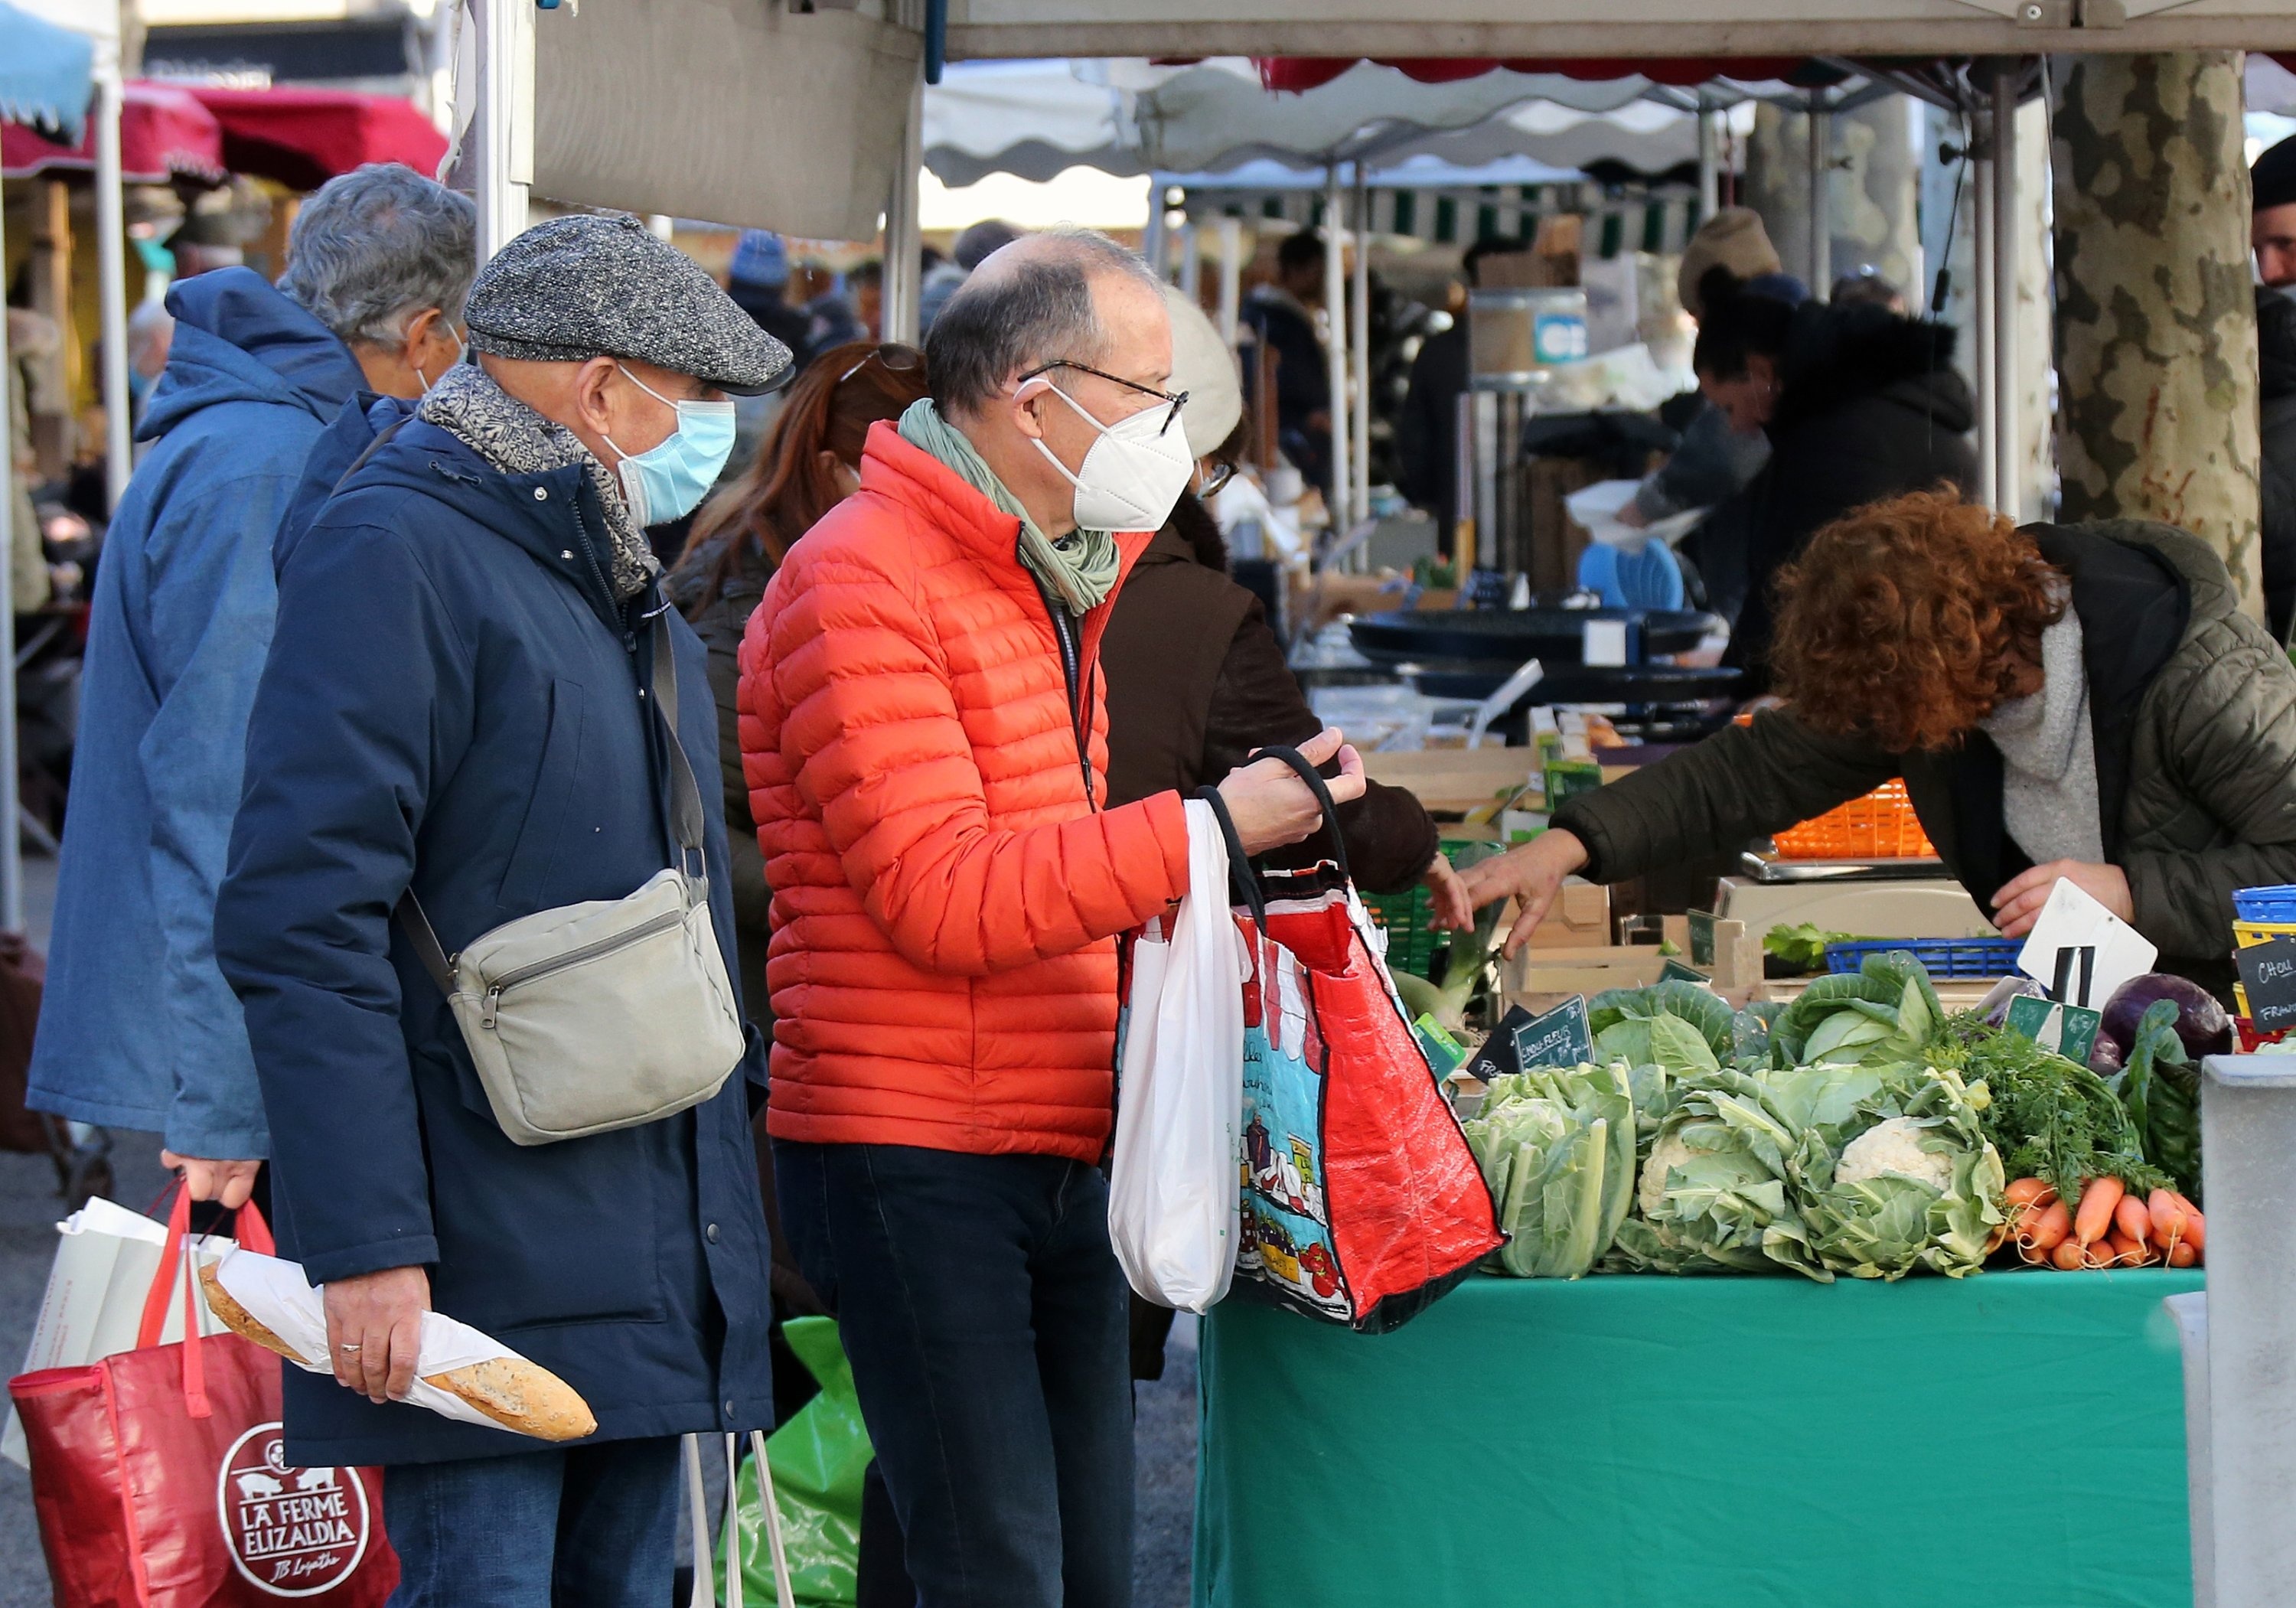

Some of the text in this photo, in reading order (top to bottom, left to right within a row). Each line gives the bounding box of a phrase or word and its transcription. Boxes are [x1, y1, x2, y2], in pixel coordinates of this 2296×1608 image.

[240, 1492, 349, 1531] LA FERME
[245, 1518, 355, 1555] ELIZALDIA
